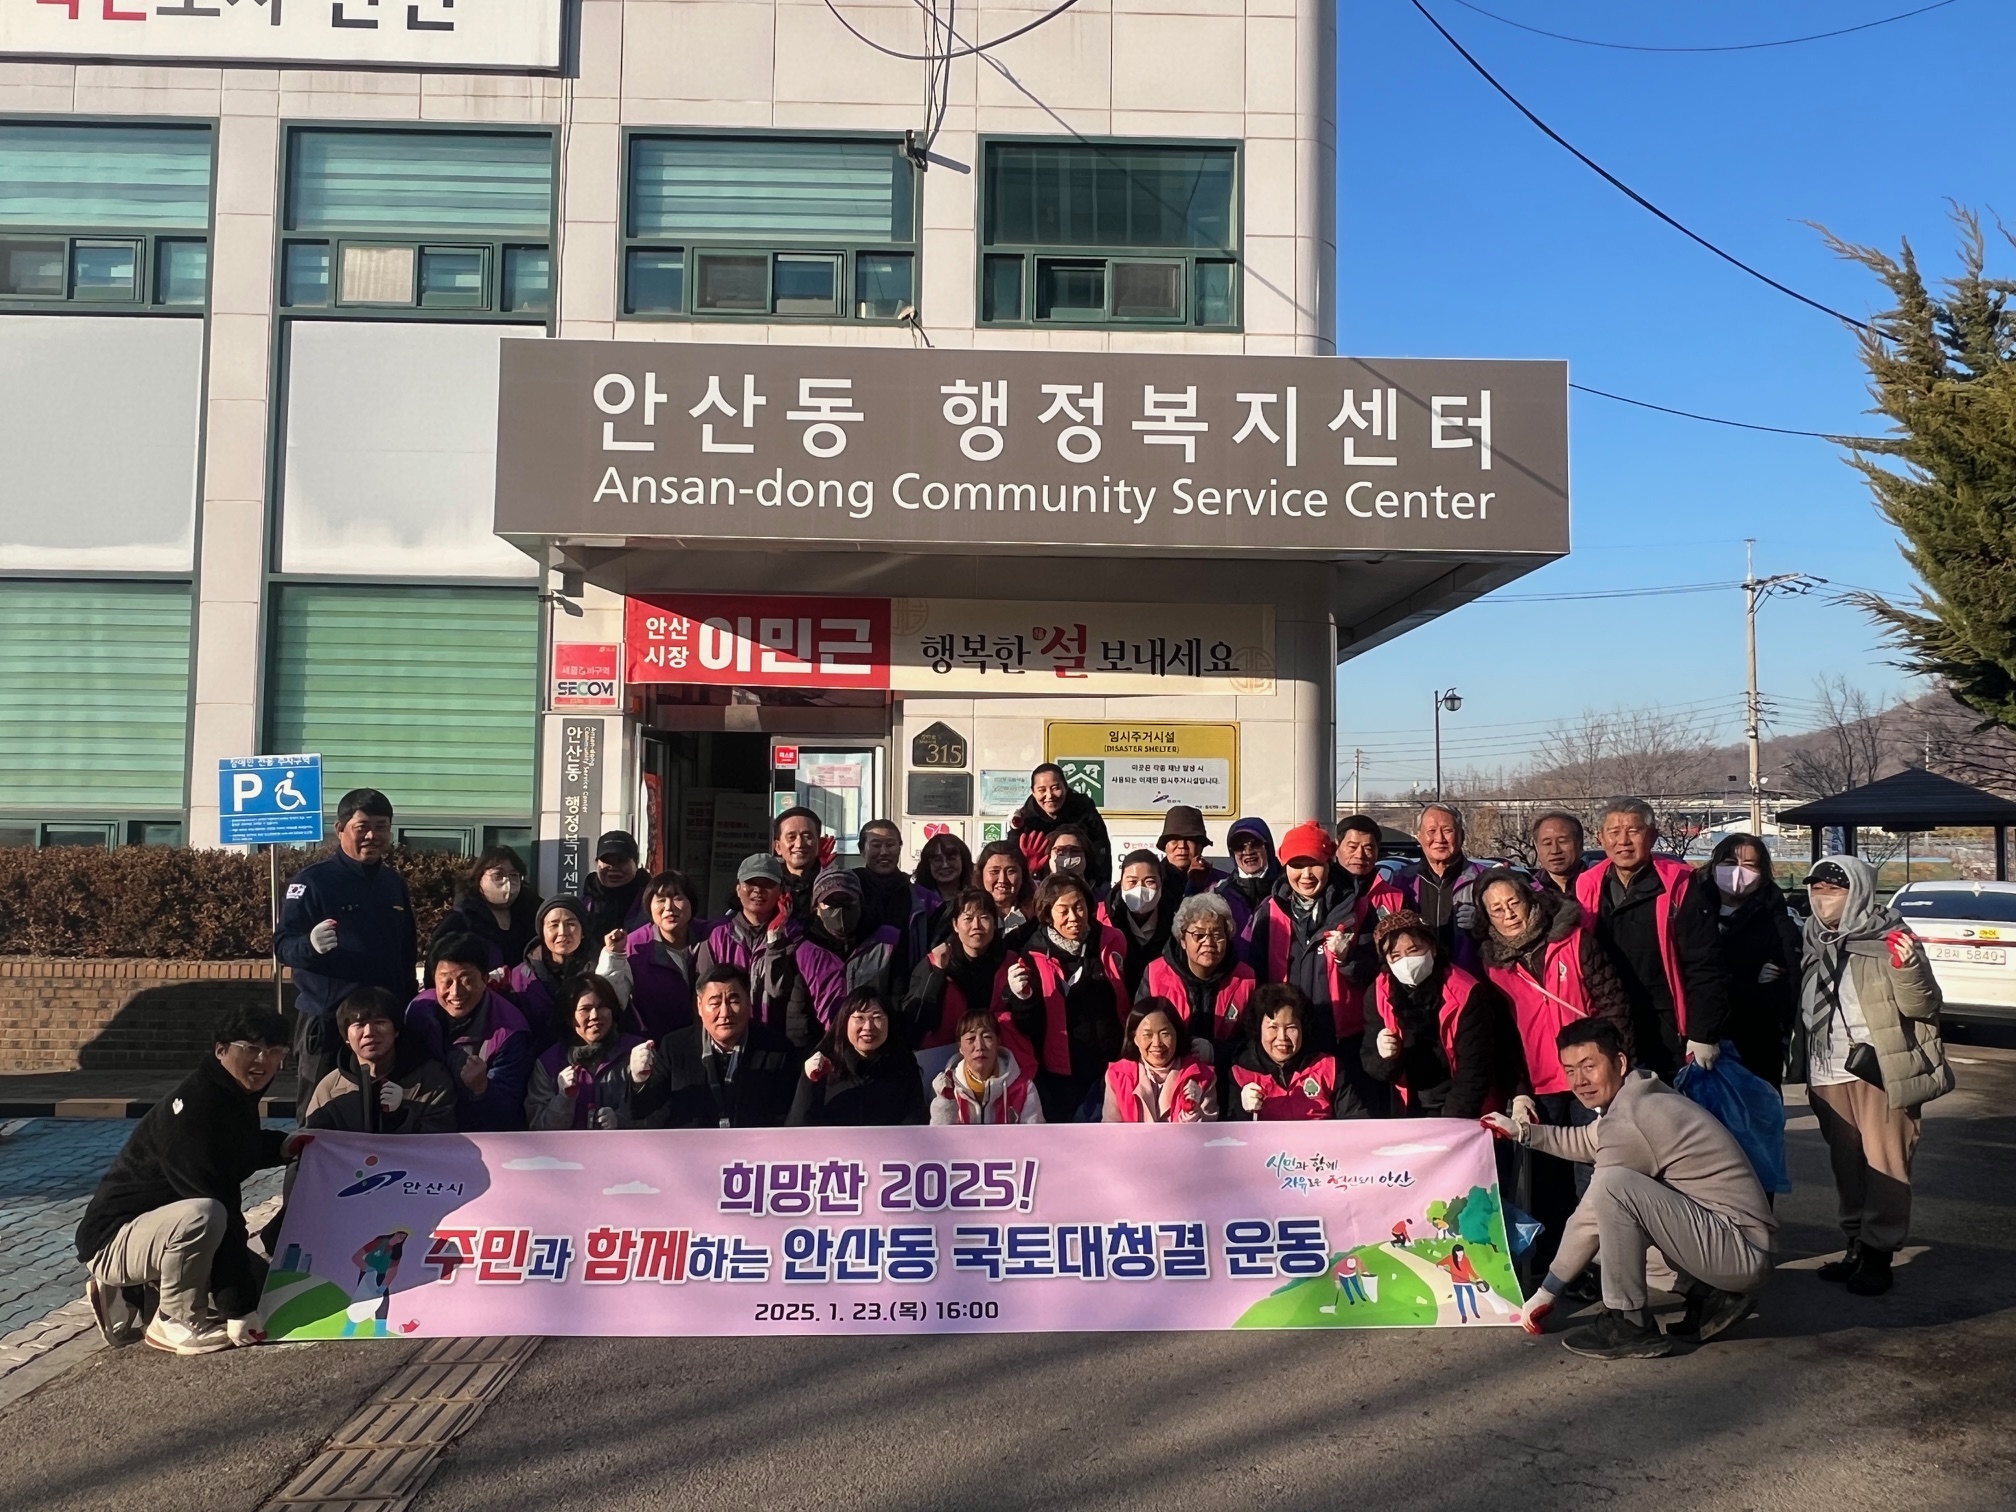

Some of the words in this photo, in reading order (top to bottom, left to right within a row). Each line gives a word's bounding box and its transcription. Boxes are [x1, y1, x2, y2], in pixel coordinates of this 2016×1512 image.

[593, 372, 865, 458] 안산동
[940, 379, 1492, 470] 행정복지센터
[593, 467, 875, 519] Ansan-dong
[892, 472, 1157, 523] Community
[1172, 477, 1328, 517] Service
[1345, 481, 1496, 520] Center
[645, 616, 691, 641] 안산
[643, 645, 691, 669] 시장
[699, 616, 873, 676] 이민근
[921, 633, 1031, 675] 행복한
[1041, 623, 1088, 678] 설
[1096, 637, 1240, 678] 보내세요
[557, 681, 614, 697] SECOM
[1103, 744, 1143, 753] (DISASTER
[1144, 745, 1180, 754] SHELTER)
[1108, 730, 1176, 744] 임시주거시설
[565, 726, 583, 782] 안산동
[925, 743, 962, 764] 315
[233, 773, 263, 812] P
[563, 795, 581, 897] 행정복지센
[402, 1181, 464, 1197] 안산시
[719, 1160, 867, 1215] 희망찬
[880, 1158, 1037, 1213] 2025!
[1379, 1170, 1416, 1188] 안산
[423, 1227, 574, 1282] 주민과
[583, 1226, 771, 1283] 함께하는
[782, 1225, 938, 1283] 안산동
[953, 1220, 1210, 1283] 국토대청결
[1223, 1217, 1328, 1279] 운동
[755, 1303, 820, 1321] 2025.
[829, 1303, 844, 1321] 1.
[936, 1301, 999, 1319] 16:00
